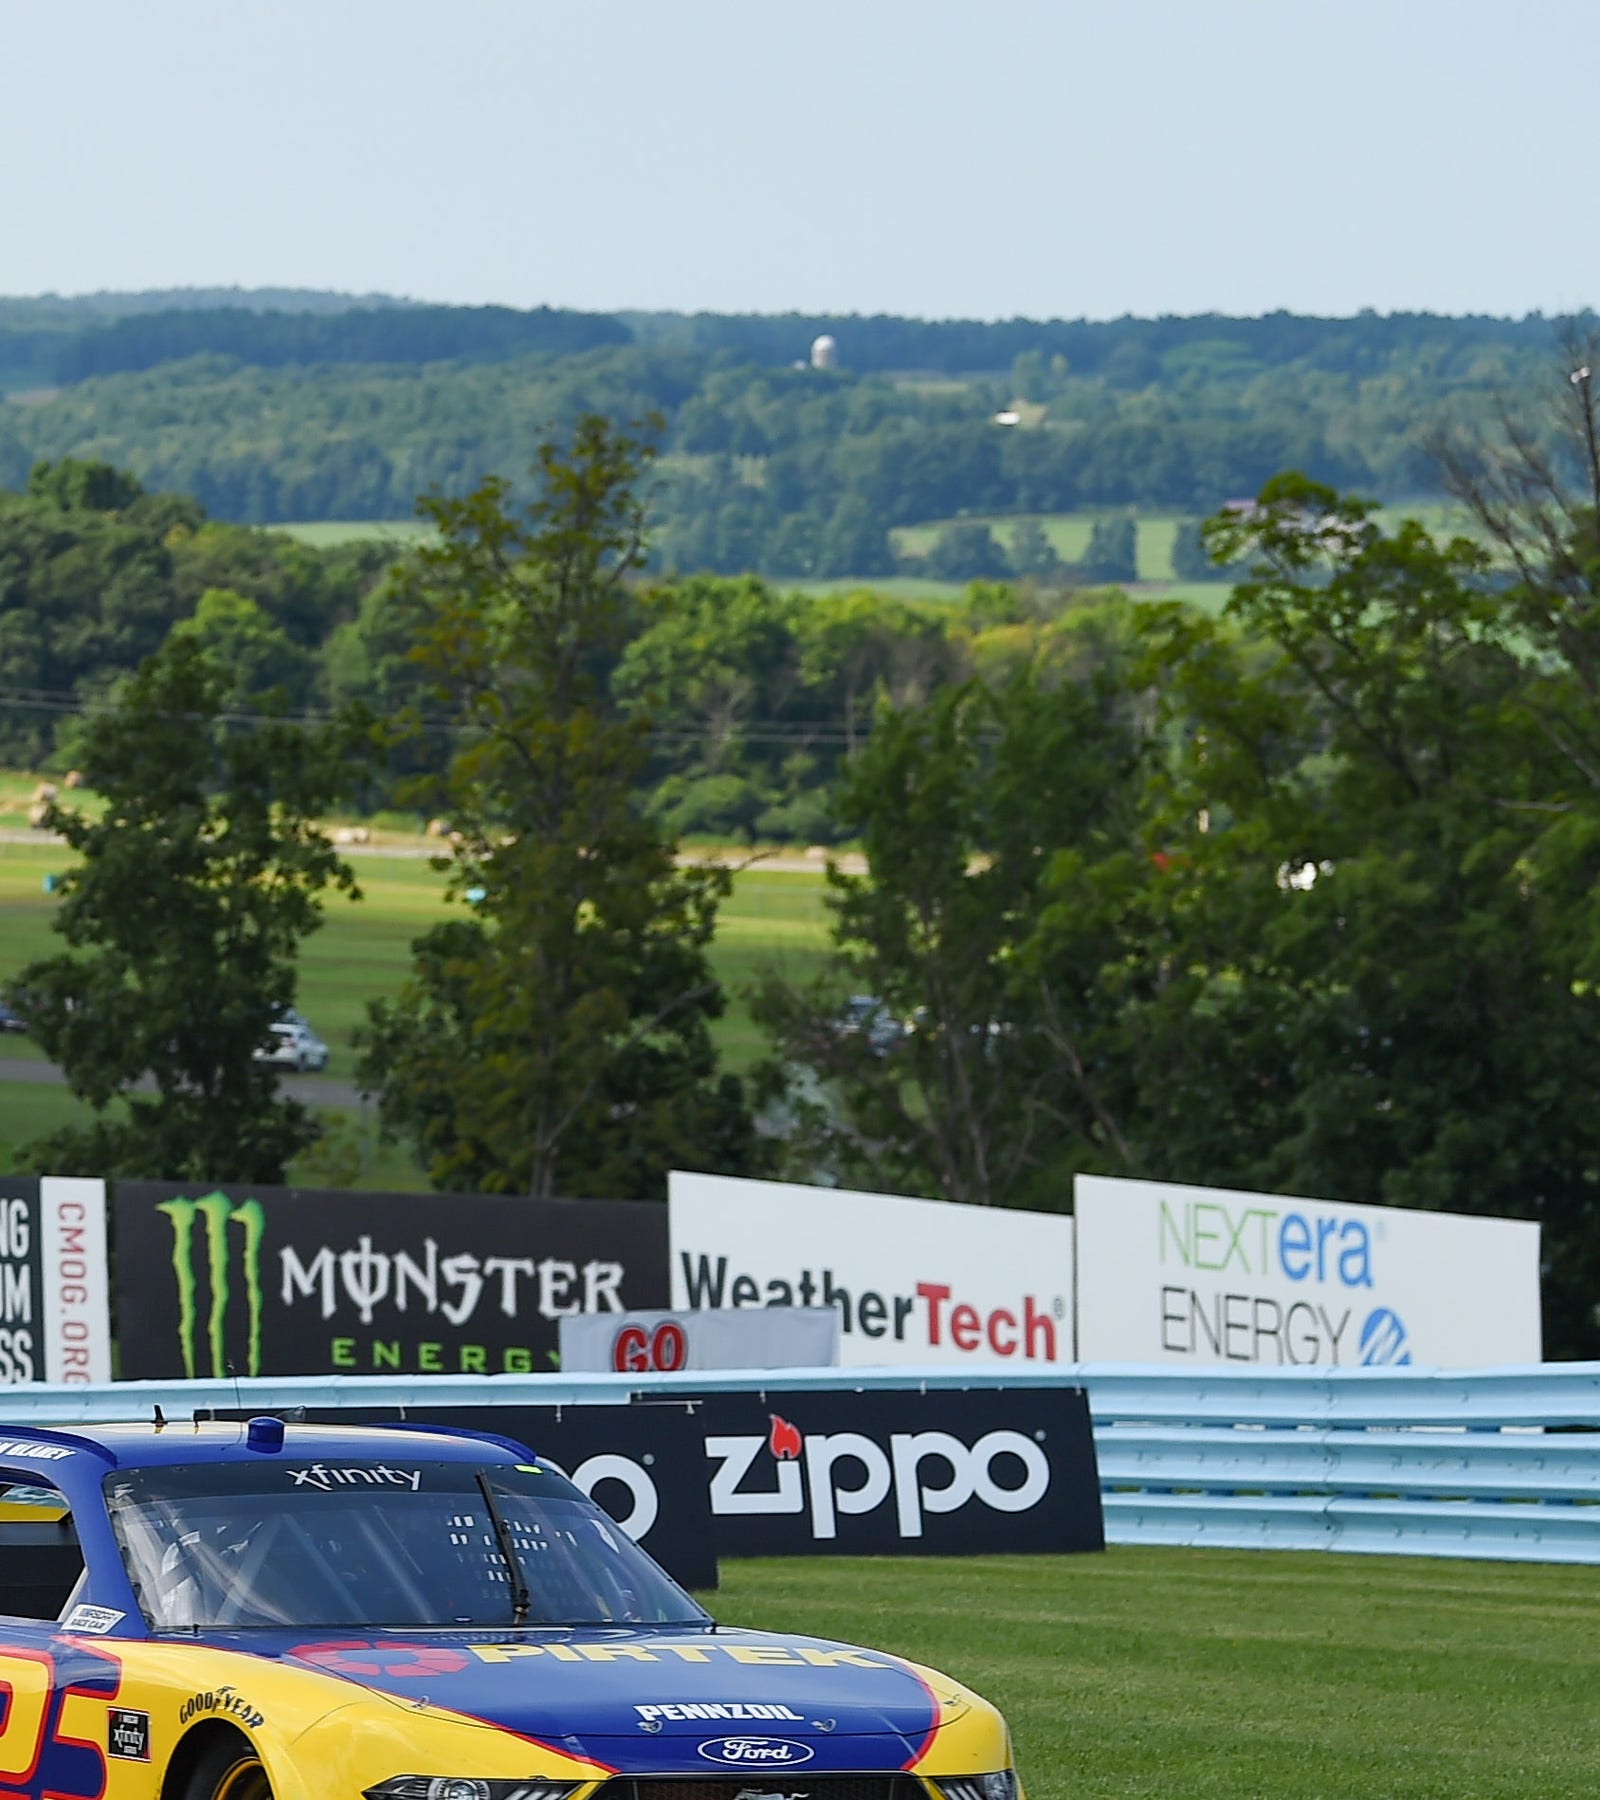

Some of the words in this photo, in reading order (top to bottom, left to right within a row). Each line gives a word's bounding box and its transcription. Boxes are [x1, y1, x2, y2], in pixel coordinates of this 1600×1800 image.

[1160, 1201, 1374, 1288] NEXTera
[279, 1234, 627, 1327] MONSTER
[681, 1251, 1058, 1362] WeatherTech
[1161, 1286, 1351, 1365] ENERGY
[286, 1464, 422, 1491] xfinity
[467, 1644, 892, 1669] PIRTEK
[178, 1686, 265, 1730] GOODYEAR
[634, 1703, 804, 1721] PENNZOIL
[720, 1739, 792, 1761] Ford
